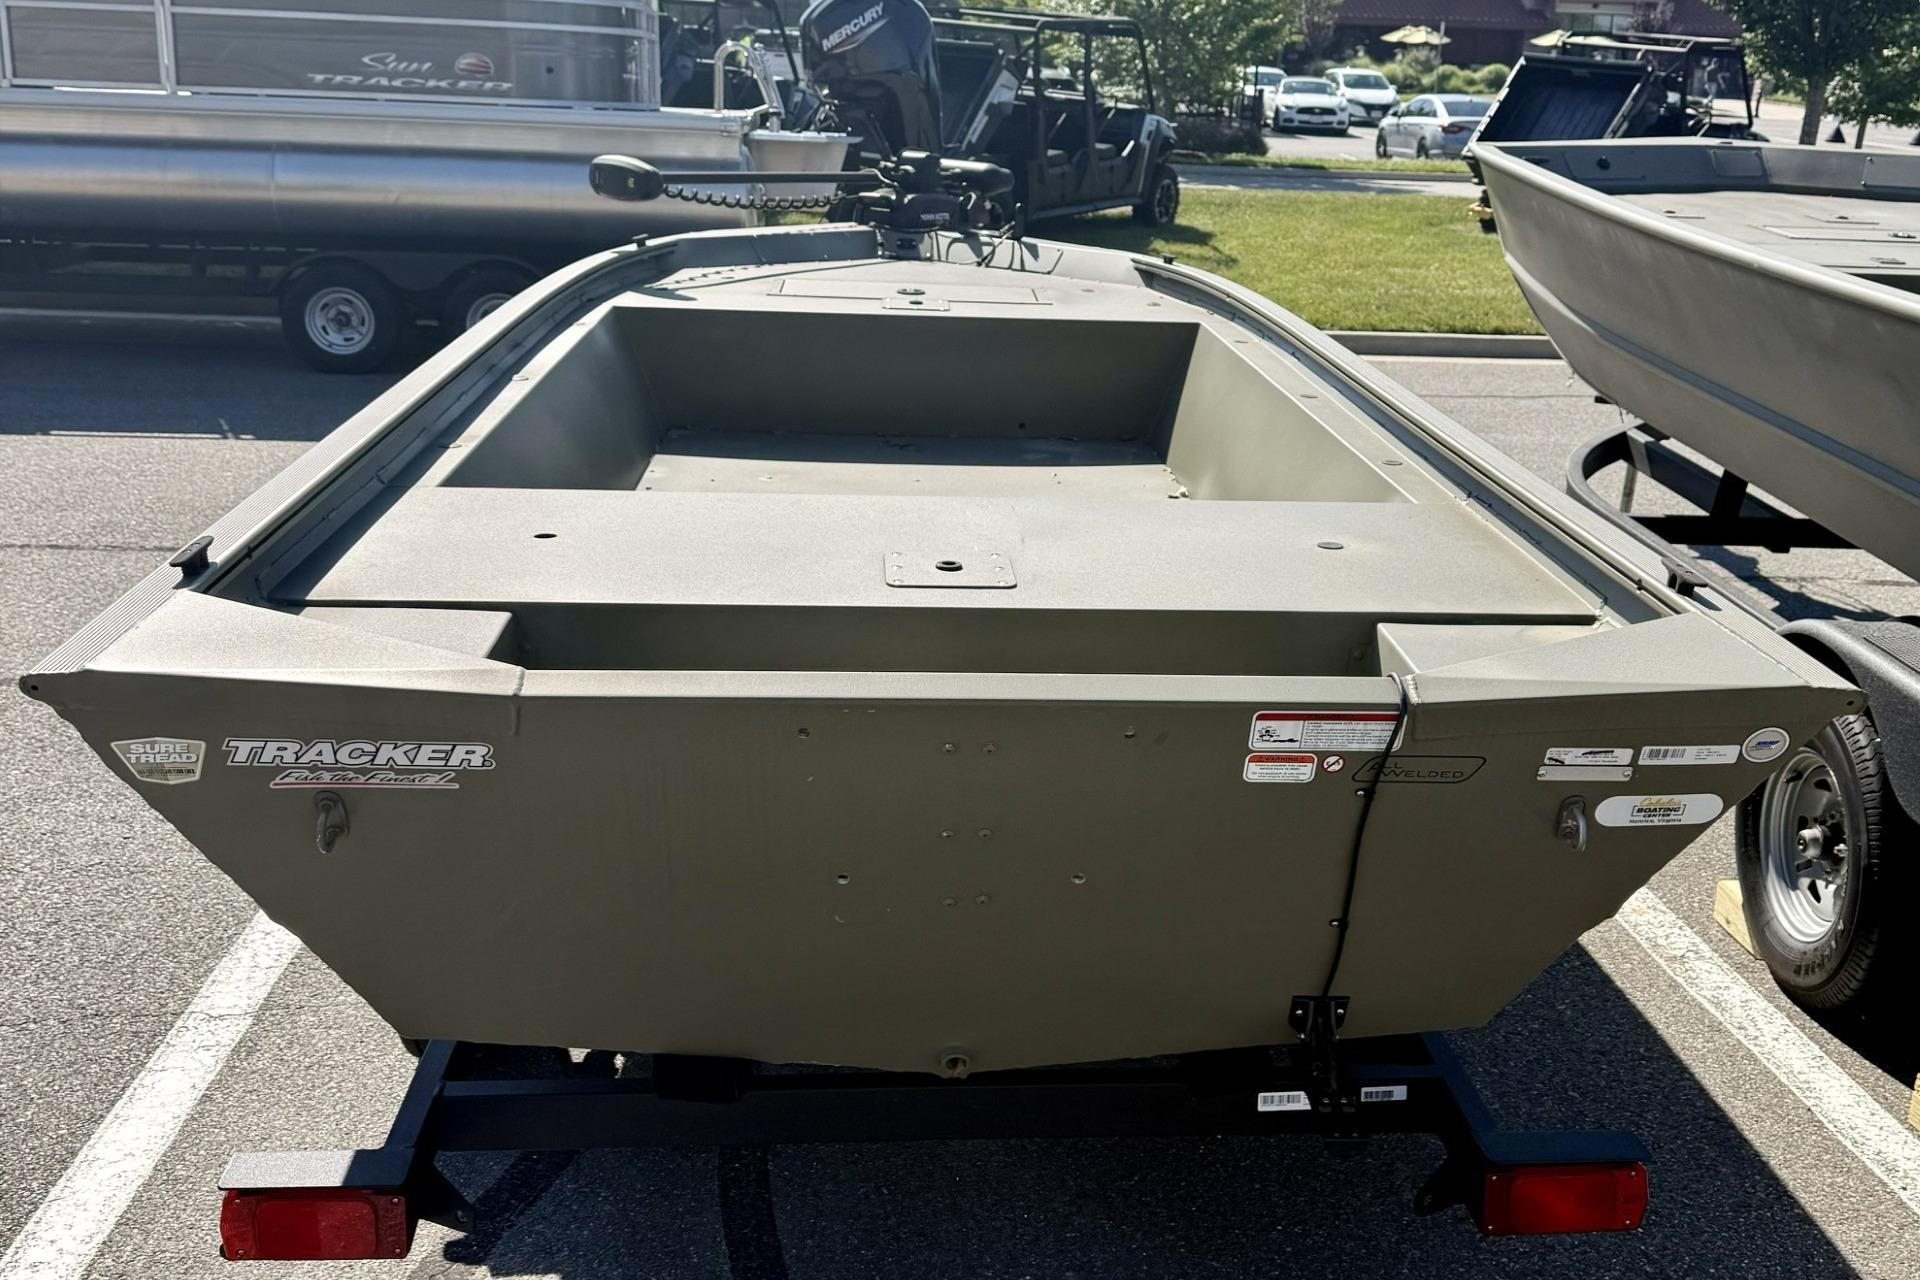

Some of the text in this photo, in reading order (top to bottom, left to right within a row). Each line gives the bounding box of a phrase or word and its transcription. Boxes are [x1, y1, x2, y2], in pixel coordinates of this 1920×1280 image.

[822, 1, 884, 52] MERCURY
[361, 52, 434, 72] Sun
[307, 73, 514, 91] TRACKER
[130, 743, 189, 754] SURE
[223, 738, 491, 768] TRACKER
[126, 753, 198, 764] TREAD
[277, 771, 326, 783] Fish
[327, 771, 361, 783] the
[1380, 769, 1464, 779] WELDED
[1636, 806, 1681, 814] BOATING
